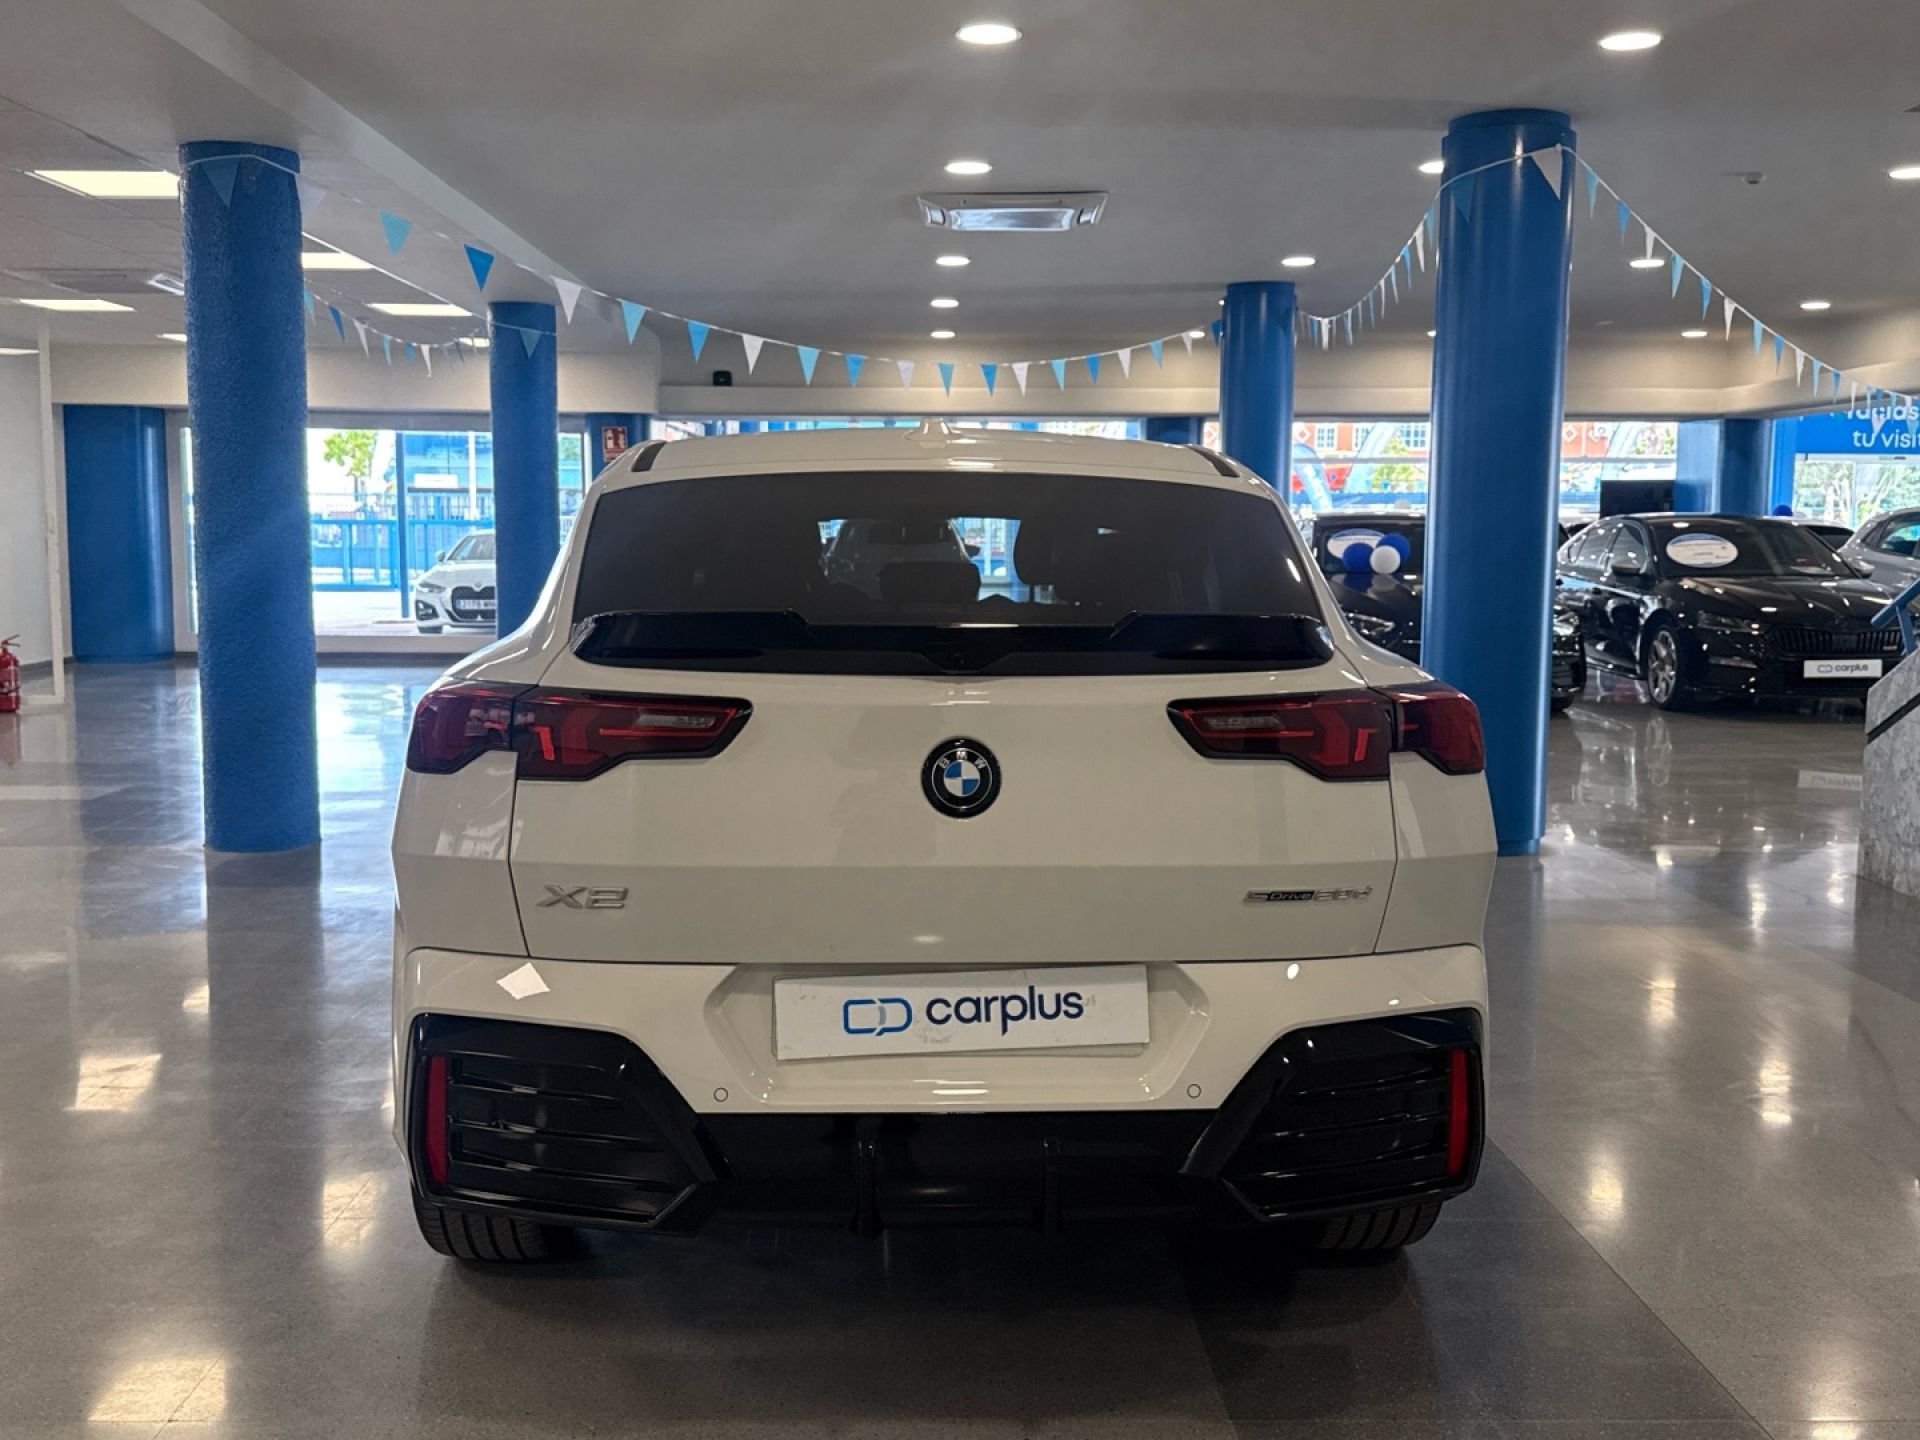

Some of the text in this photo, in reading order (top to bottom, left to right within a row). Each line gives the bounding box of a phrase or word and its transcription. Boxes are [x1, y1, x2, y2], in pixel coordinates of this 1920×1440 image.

[1853, 430, 1875, 448] tu
[1835, 664, 1868, 674] carplus
[939, 750, 988, 769] BMW
[536, 885, 628, 909] X2
[925, 984, 1085, 1036] carplus
